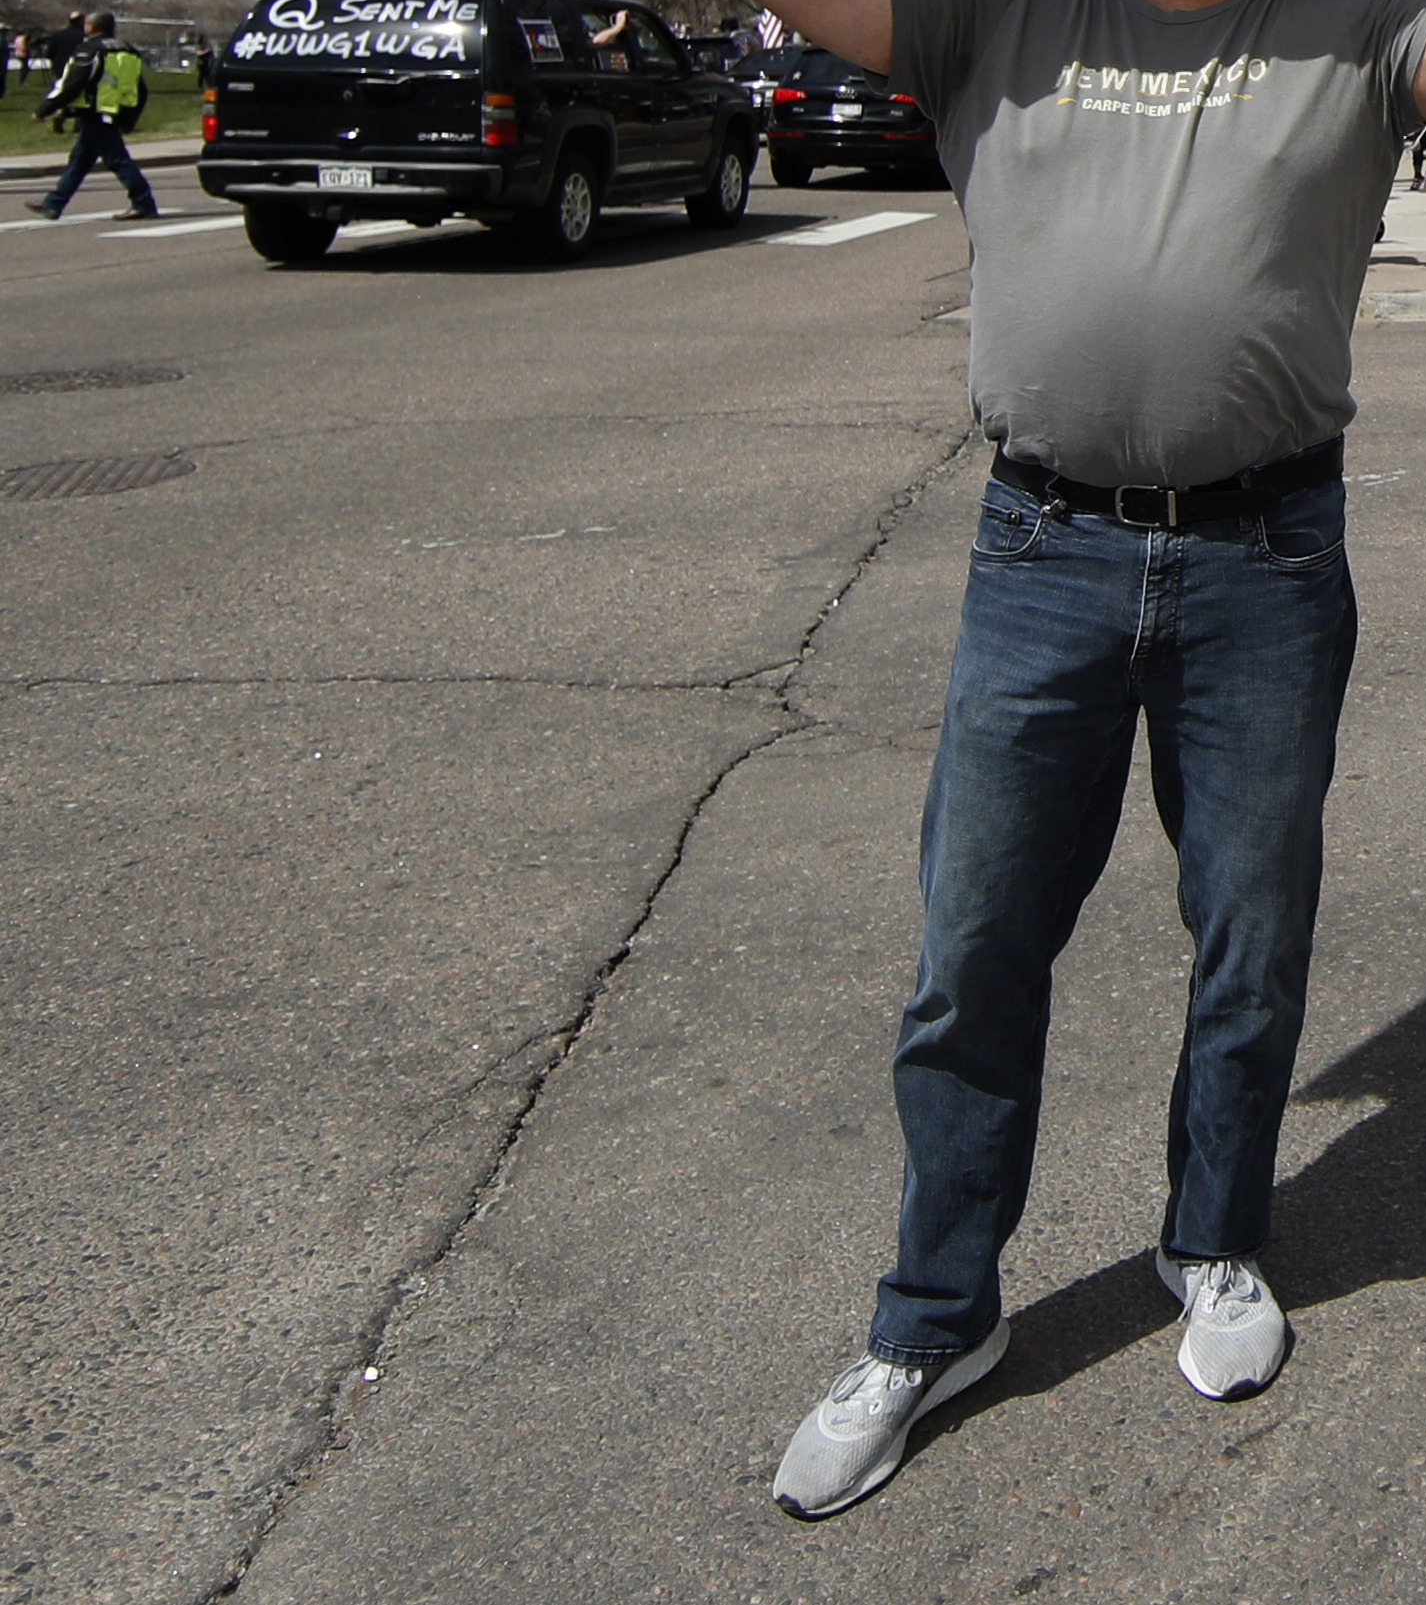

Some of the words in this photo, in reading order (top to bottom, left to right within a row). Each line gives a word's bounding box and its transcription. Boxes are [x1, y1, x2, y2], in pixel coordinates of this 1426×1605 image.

[233, 30, 467, 62] #WWG1WGA
[1054, 62, 1130, 92] NEW
[1141, 55, 1268, 96] MEXICO
[1082, 97, 1131, 115] CARPE
[1135, 101, 1171, 117] DIEM
